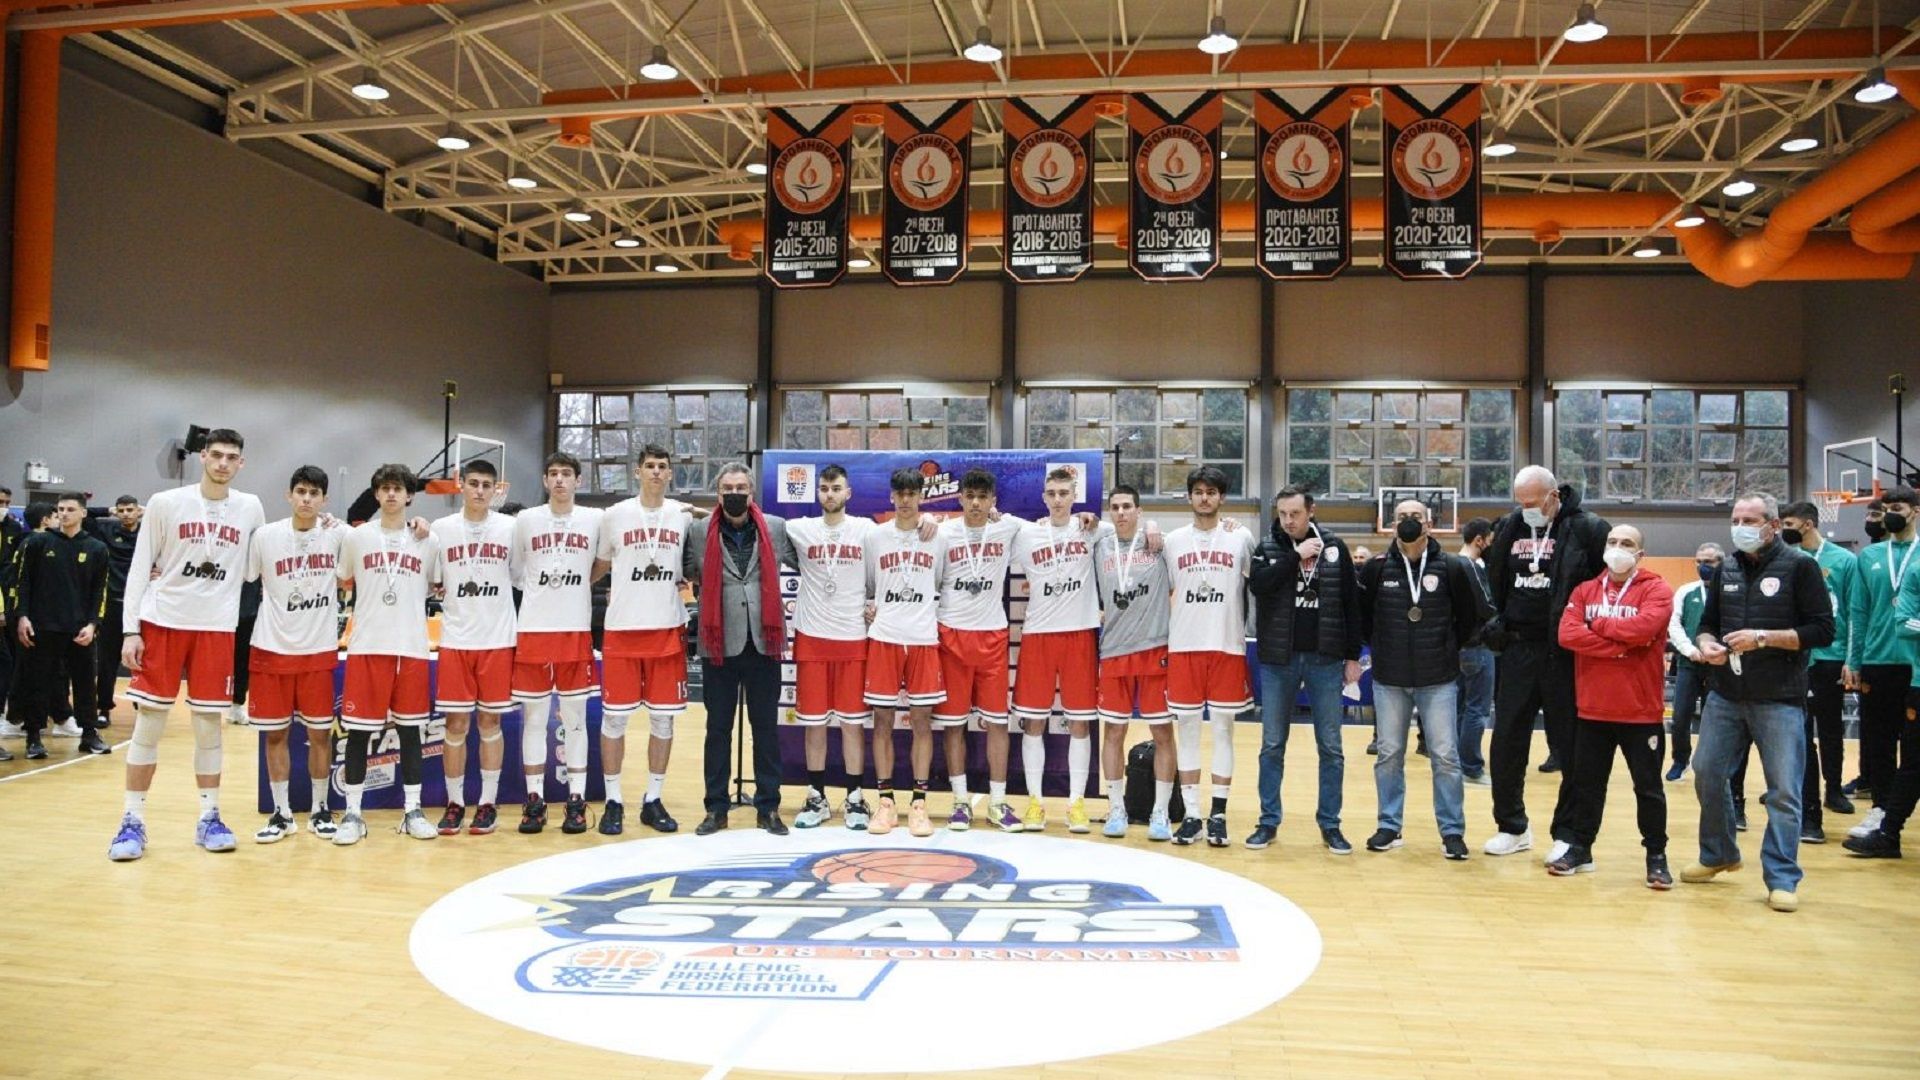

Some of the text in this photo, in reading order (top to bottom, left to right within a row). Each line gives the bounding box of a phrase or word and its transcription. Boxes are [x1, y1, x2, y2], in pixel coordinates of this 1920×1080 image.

[919, 217, 944, 232] ΘΕΣΗ
[1012, 213, 1083, 231] ΠΡΩΤΑΘΛΗΤΕΣ
[1168, 211, 1194, 227] ΘΕΣΗ
[1266, 208, 1339, 226] ΠΡΩΤΑΘΛΗΤΕΣ
[1426, 207, 1454, 224] ΘΕΣΗ
[801, 220, 826, 236] ΘΕΣΗ
[1265, 226, 1340, 247] 2020-2021
[1394, 225, 1472, 246] 2020-2021
[774, 237, 838, 257] 2015-2016
[891, 234, 958, 254] 2017-2018
[1012, 231, 1082, 252] 2018-2019
[1137, 228, 1211, 248] 2019-2020
[924, 473, 950, 484] SING
[921, 480, 959, 499] TARS
[539, 569, 582, 586] bin
[457, 581, 499, 598] bin
[1043, 577, 1081, 597] bin
[226, 675, 235, 696] 1
[677, 681, 688, 700] 15
[336, 717, 447, 762] STAS
[691, 880, 1092, 901] RISING
[582, 904, 1201, 943] STARS
[733, 945, 1229, 961] U18 TOURNAMENT
[673, 962, 801, 973] HELLENIC
[668, 972, 831, 983] BASKETBALL
[660, 981, 838, 993] FEDERATION
